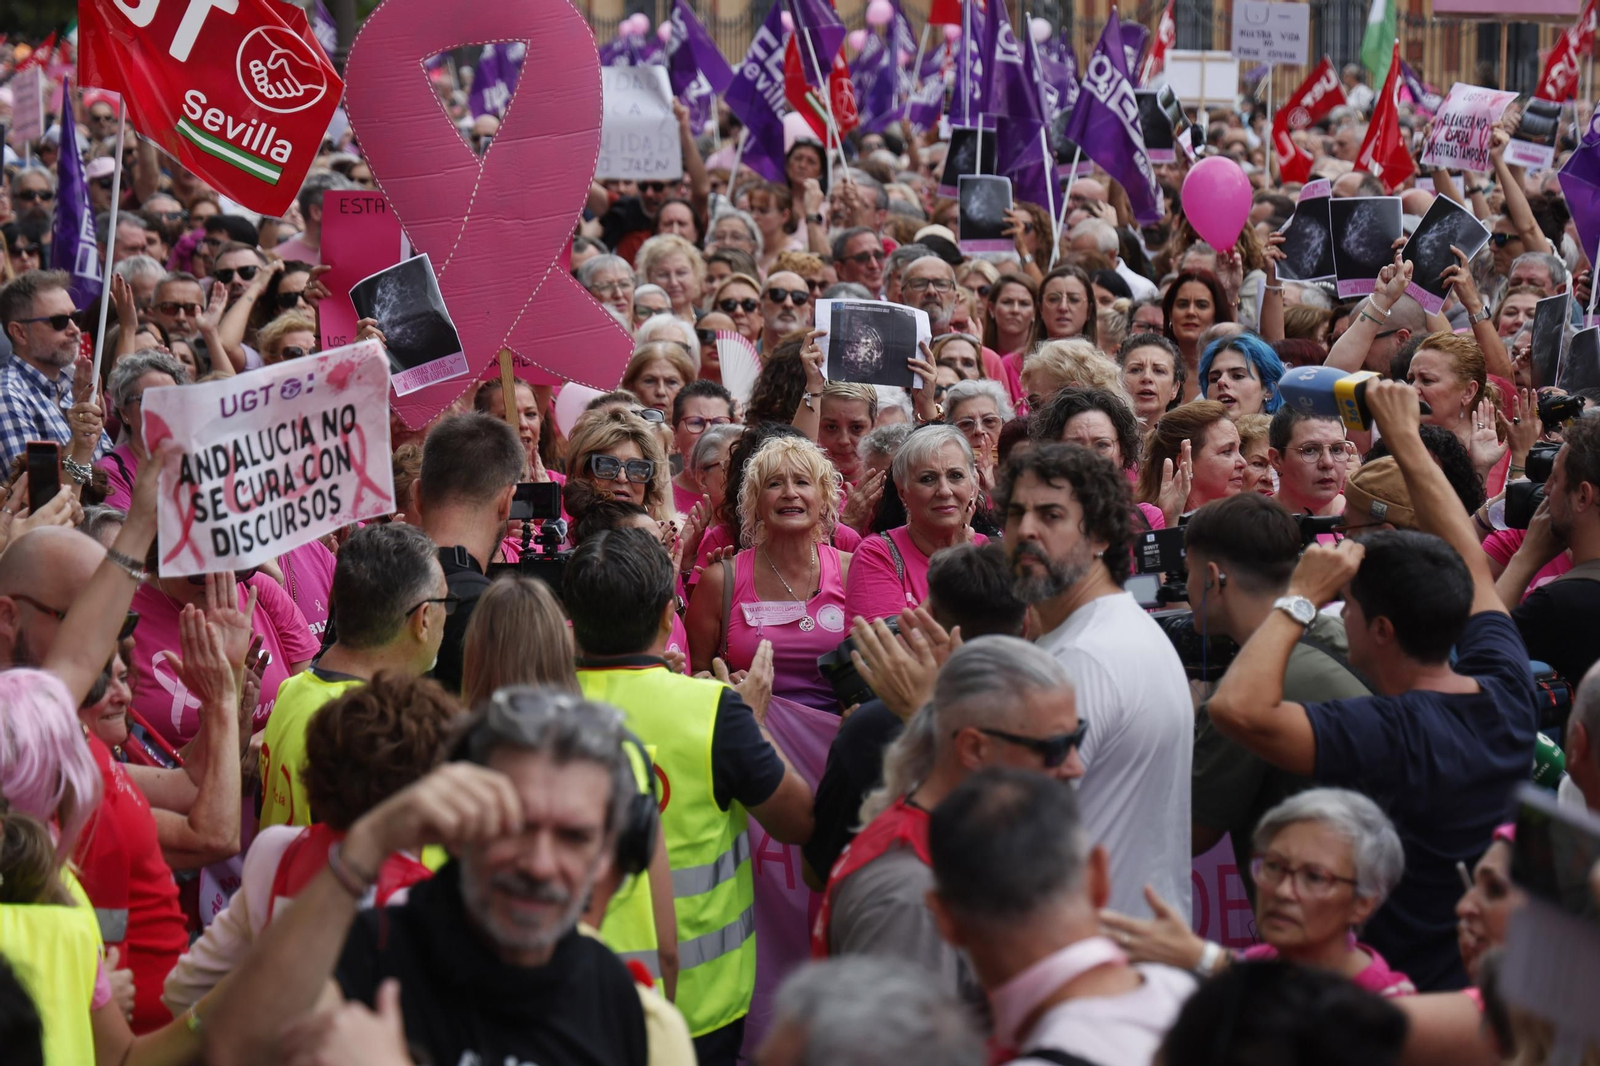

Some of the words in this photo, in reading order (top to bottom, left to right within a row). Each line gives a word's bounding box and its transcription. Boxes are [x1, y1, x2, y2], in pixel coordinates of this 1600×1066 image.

[182, 89, 293, 164] Sevilla
[340, 198, 386, 214] ESTA
[328, 334, 346, 348] LOS
[428, 360, 447, 372] VIDAS
[220, 384, 275, 418] UGT
[180, 416, 316, 486] ANDALUCIA
[322, 404, 356, 442] NO
[191, 486, 228, 523] SE
[234, 461, 297, 513] CURA
[302, 441, 352, 486] CON
[210, 483, 342, 558] DISCURSOS
